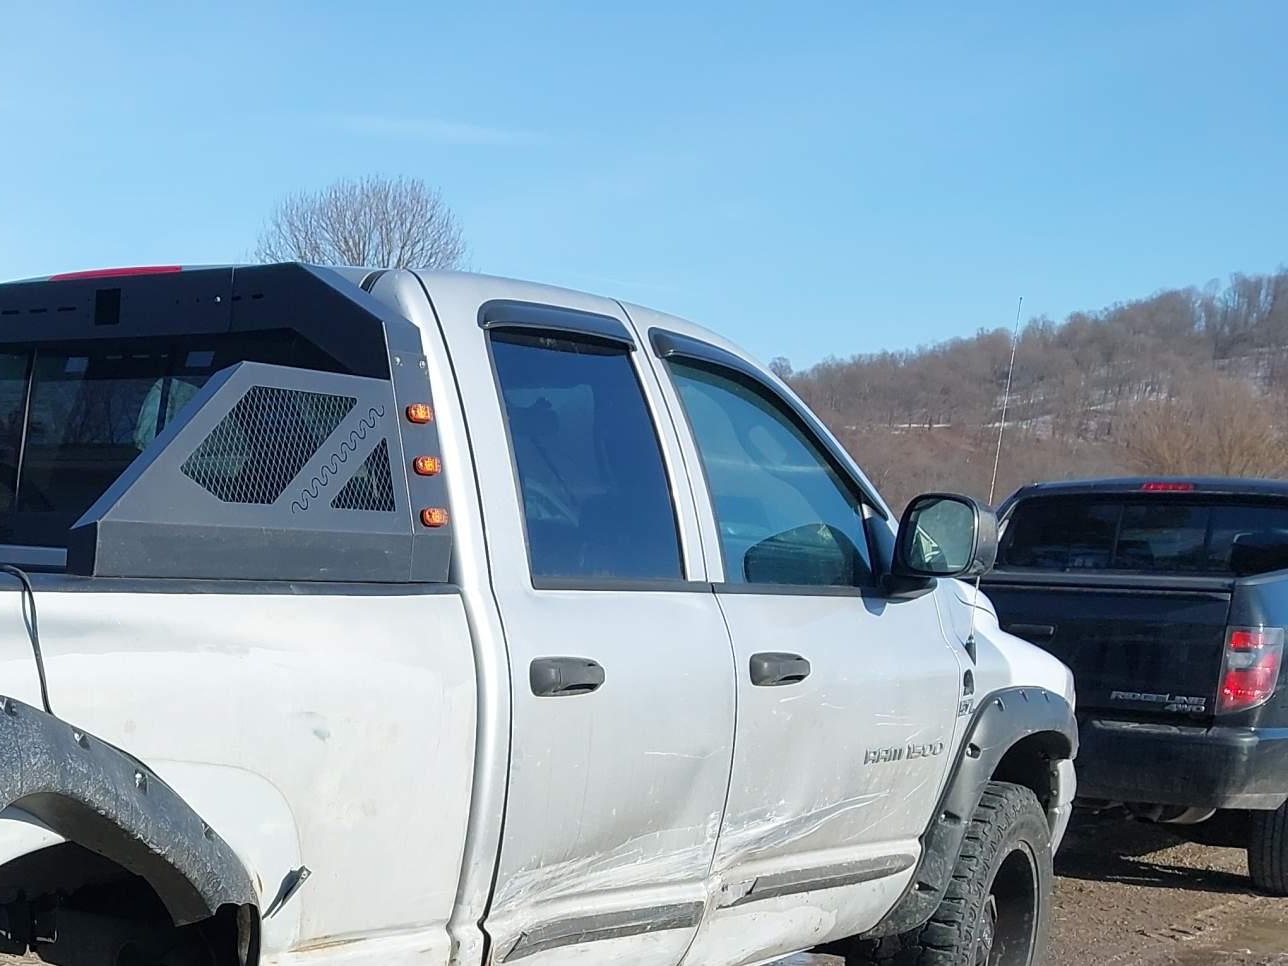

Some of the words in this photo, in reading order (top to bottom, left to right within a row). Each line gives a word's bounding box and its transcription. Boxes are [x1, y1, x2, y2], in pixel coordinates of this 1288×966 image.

[1110, 690, 1207, 705] RIDGELINE
[864, 748, 903, 765] RAM
[906, 742, 943, 760] 1500
